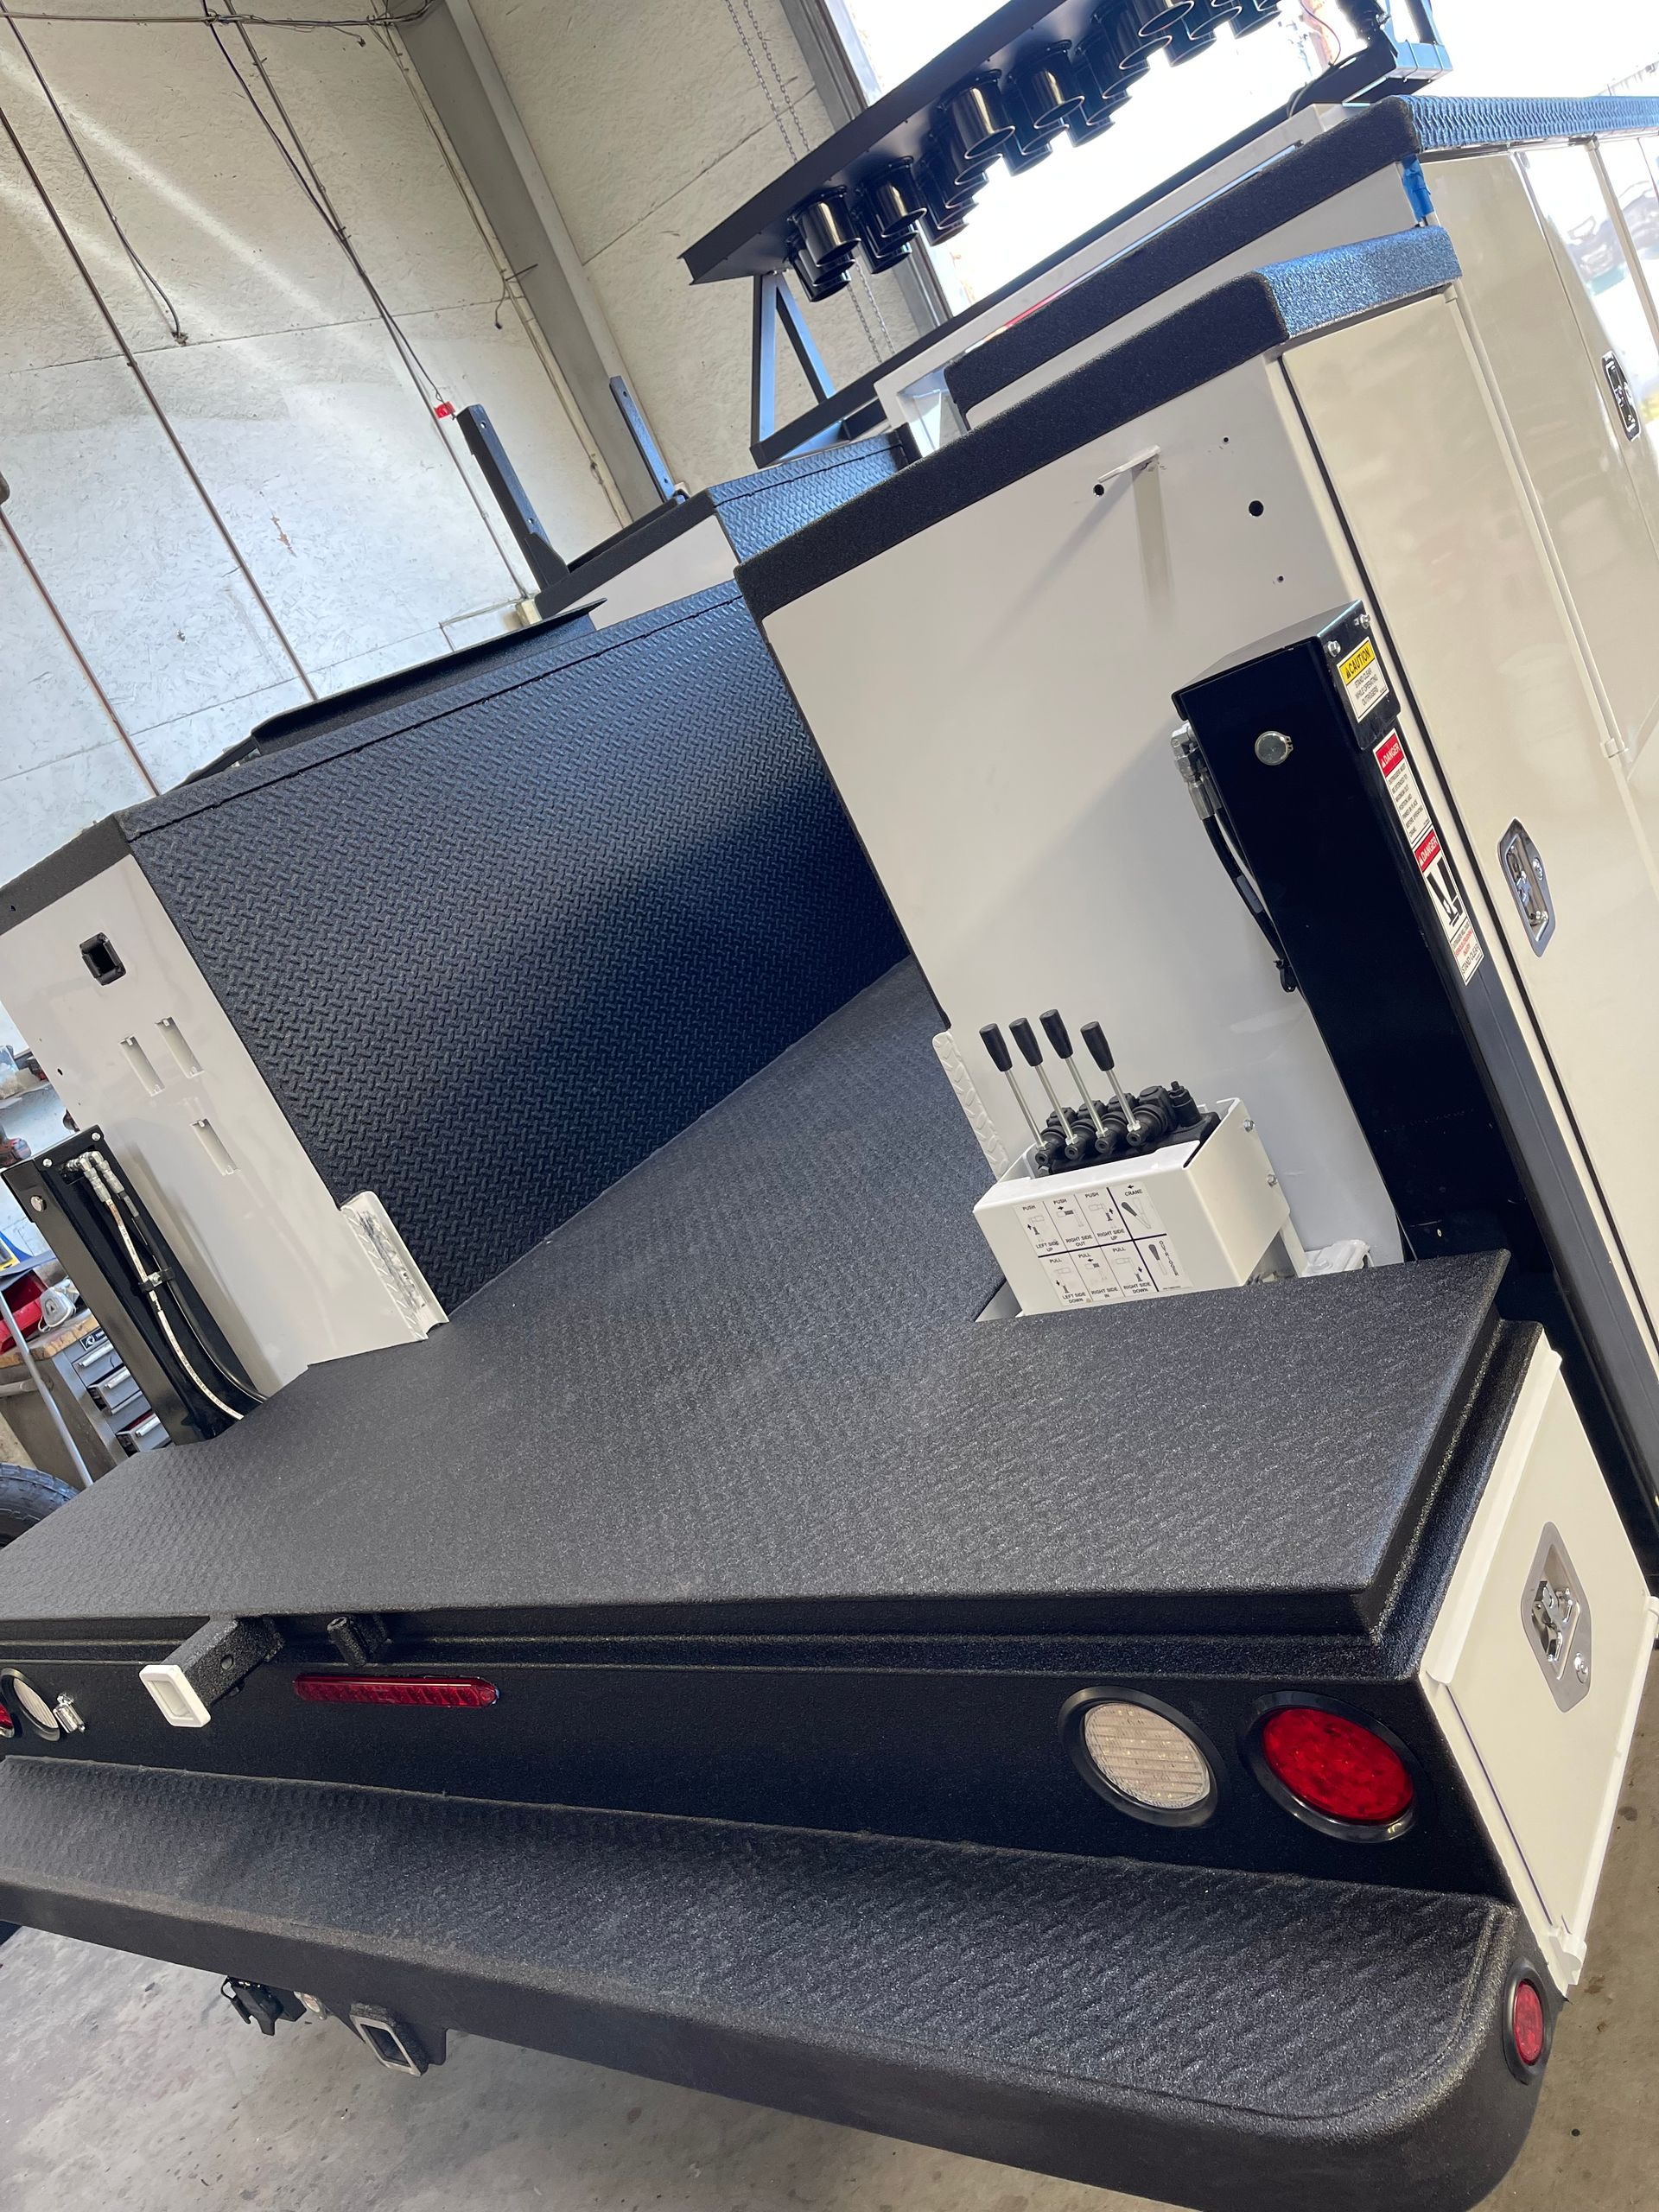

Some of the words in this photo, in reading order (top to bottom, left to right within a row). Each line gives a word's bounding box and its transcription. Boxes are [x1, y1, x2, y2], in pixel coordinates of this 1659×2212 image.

[1348, 647, 1371, 674] CAUTION
[1384, 742, 1400, 765] DANGER
[1421, 836, 1438, 861] DANGER
